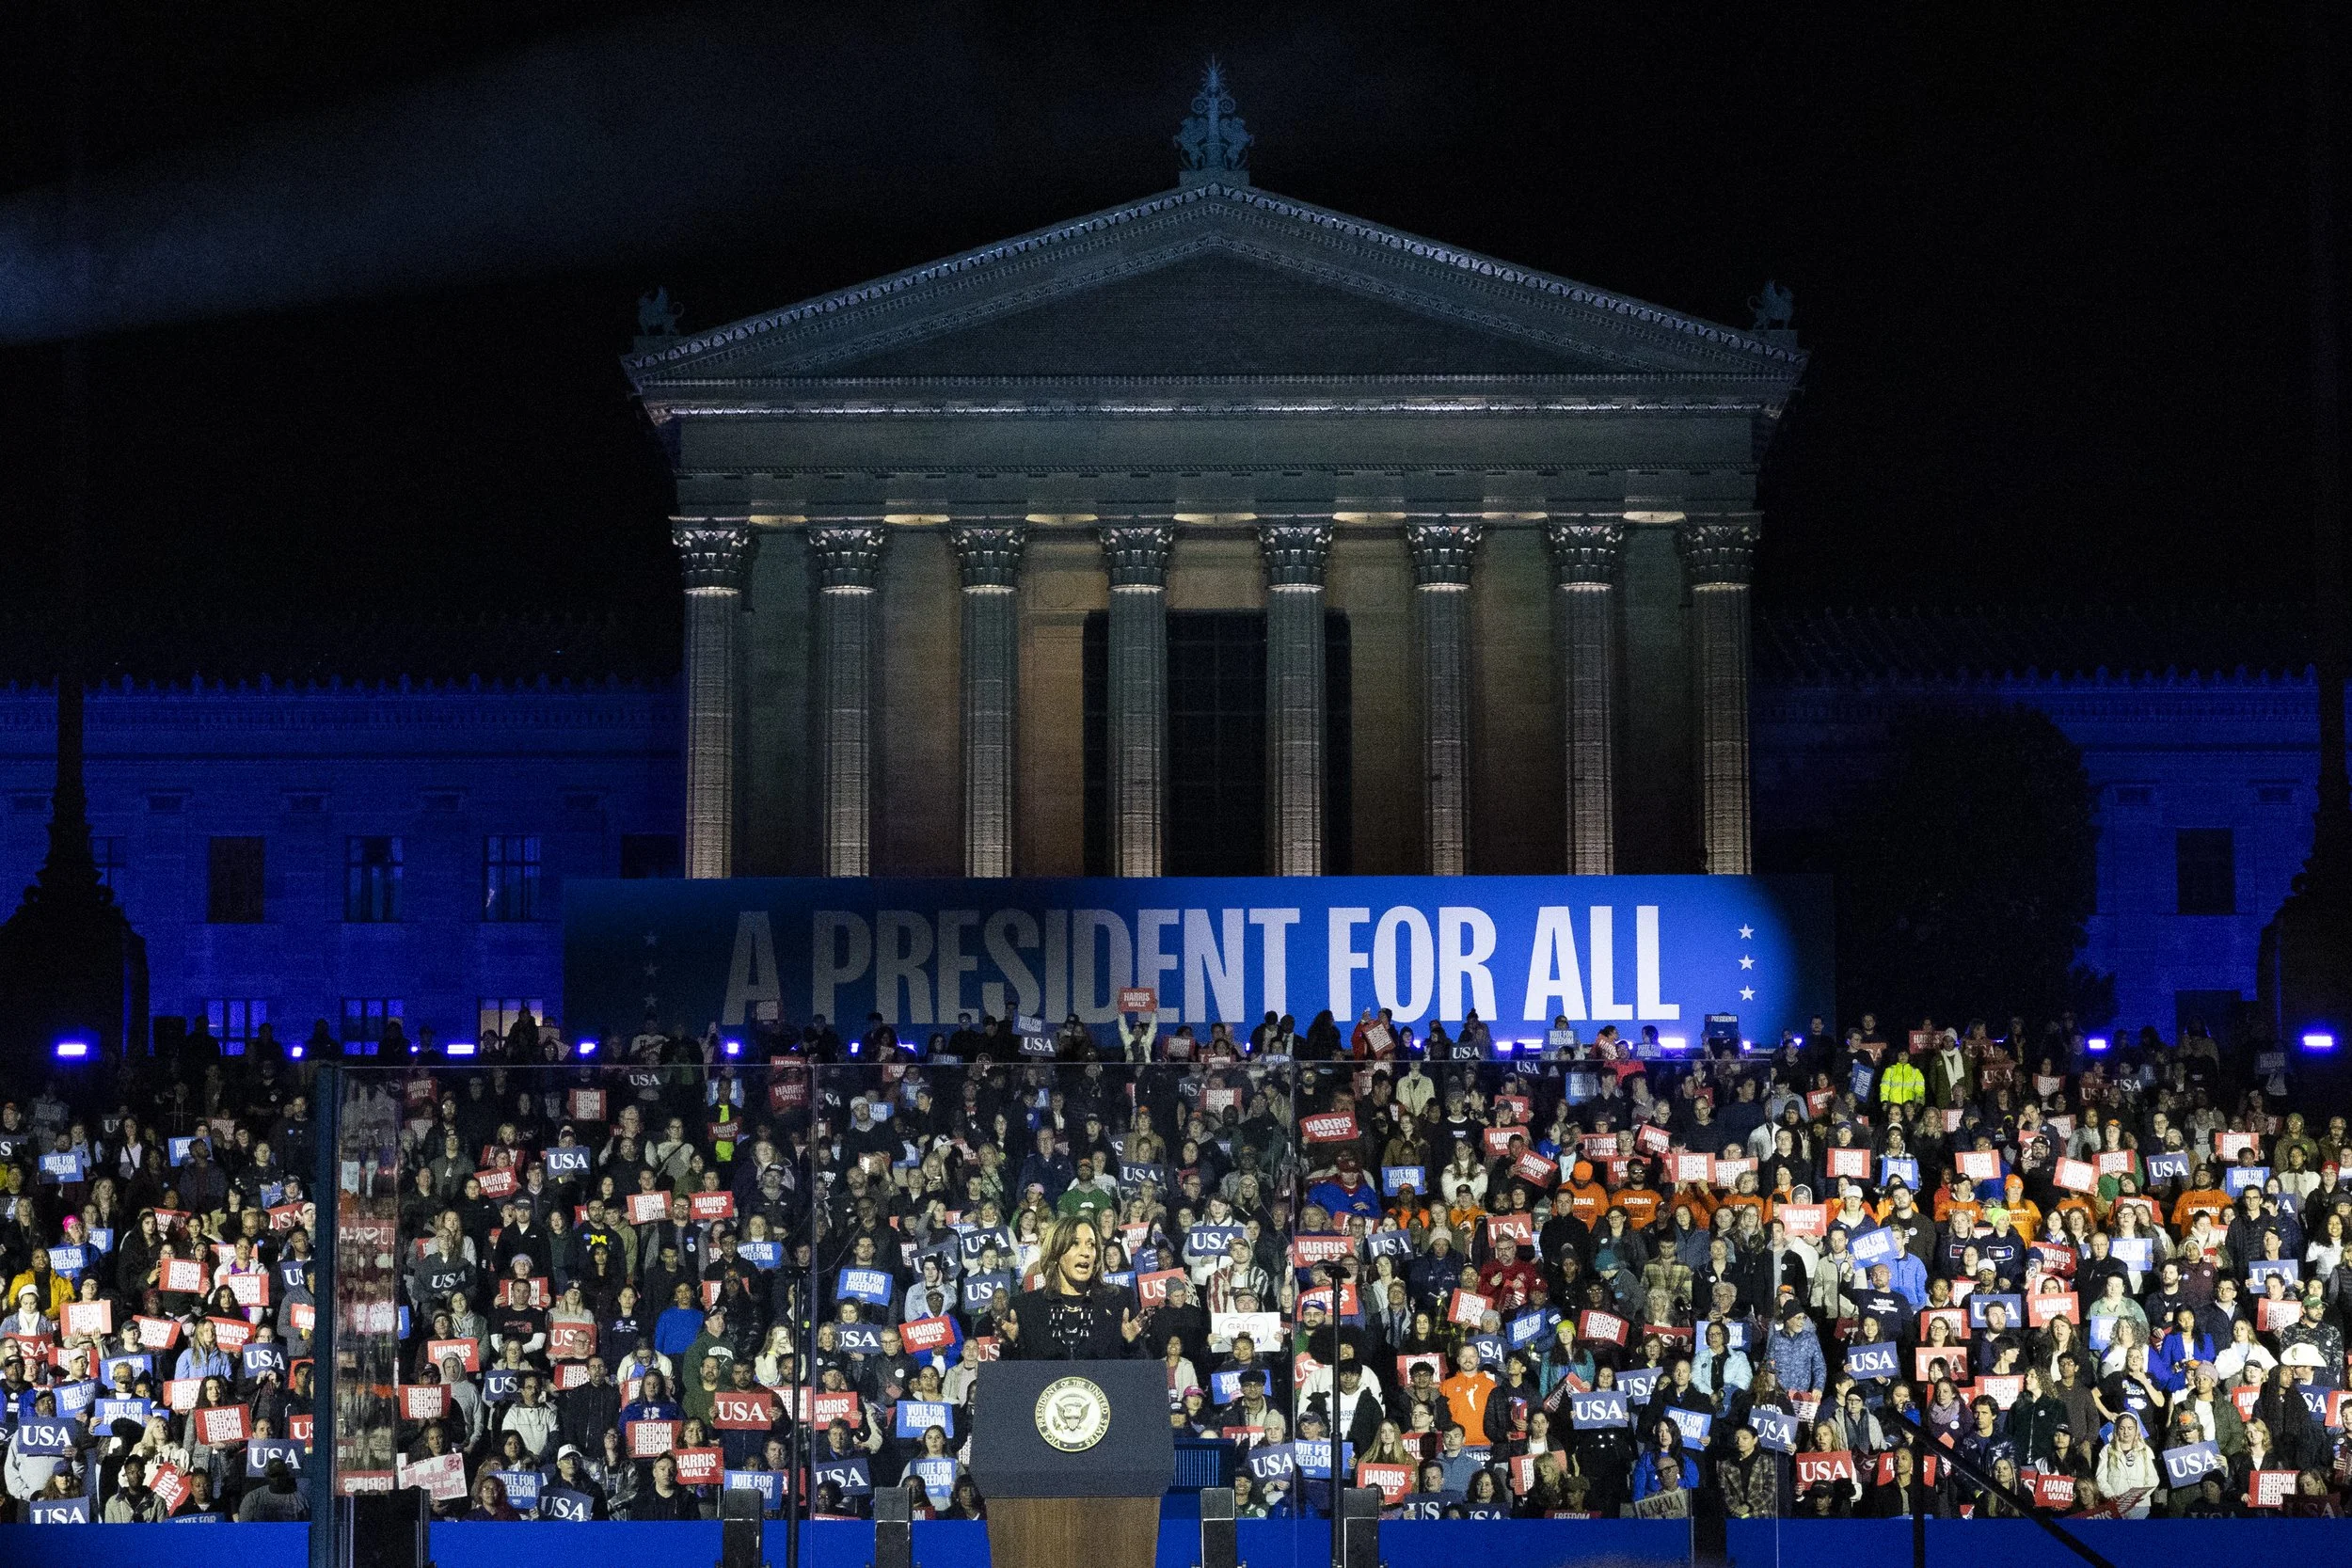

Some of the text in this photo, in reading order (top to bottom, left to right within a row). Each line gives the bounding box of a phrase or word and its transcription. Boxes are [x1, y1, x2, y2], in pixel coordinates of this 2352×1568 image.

[723, 906, 1679, 1026] A PRESIDENT FOR ALL
[1123, 991, 1150, 1003] HARRIS
[1128, 1000, 1146, 1008] WALZ
[1020, 1017, 1042, 1027] VOTE FOR
[1019, 1024, 1042, 1033] FREEDOM
[1024, 1037, 1054, 1052] USA
[1914, 1035, 1940, 1044] HARRIS
[1453, 1046, 1481, 1059] USA
[1517, 1061, 1539, 1074] USA
[629, 1074, 660, 1085] USA
[1571, 1072, 1584, 1085] VOTE
[1983, 1069, 2013, 1083] USA
[407, 1080, 433, 1092] HARRIS
[774, 1085, 805, 1097] HARRIS
[1571, 1083, 1597, 1097] FREEDOM
[576, 1092, 600, 1101] FREEDOM
[1206, 1089, 1234, 1099] FREEDOM
[576, 1101, 600, 1110] FREEDOM
[1206, 1098, 1234, 1106] FREEDOM
[576, 1110, 600, 1119] FREEDOM
[711, 1122, 739, 1134] HARRIS
[1306, 1117, 1352, 1132] HARRIS
[1314, 1127, 1349, 1137] WALZ
[1584, 1138, 1617, 1149] HARRIS
[1646, 1143, 1669, 1154] WALZ
[1589, 1148, 1613, 1157] WALZ
[44, 1155, 75, 1166] VOTE FOR
[549, 1153, 588, 1169] USA
[1522, 1153, 1551, 1175] HARRIS
[45, 1164, 77, 1175] FREEDOM
[1122, 1166, 1157, 1181] USA
[1389, 1168, 1419, 1180] VOTE FOR
[2151, 1161, 2188, 1178] USA
[2233, 1170, 2264, 1180] VOTE FOR
[479, 1172, 512, 1187] HARRIS
[1389, 1178, 1419, 1187] FREEDOM
[2233, 1178, 2264, 1188] FREEDOM
[485, 1182, 508, 1193] WALZ
[634, 1194, 664, 1204] FREEDOM
[694, 1196, 727, 1208] HARRIS
[636, 1202, 665, 1213] FREEDOM
[271, 1212, 302, 1230] USA
[637, 1210, 666, 1221] FREEDOM
[1786, 1210, 1821, 1222] HARRIS
[590, 1234, 608, 1244] M
[1489, 1224, 1530, 1242] USA
[1191, 1232, 1234, 1250] USA
[1851, 1232, 1886, 1251] VOTE FOR
[756, 1243, 772, 1253] FOR
[1298, 1242, 1347, 1255] HARRIS
[1371, 1239, 1411, 1257] USA
[1855, 1243, 1890, 1260] FREEDOM
[49, 1249, 82, 1261] VOTE FOR
[50, 1257, 83, 1269] FREEDOM
[431, 1270, 467, 1289] USA
[847, 1271, 885, 1284] VOTE FOR
[845, 1281, 884, 1294] FREEDOM
[1460, 1292, 1487, 1307] FREEDOM
[2035, 1300, 2072, 1311] HARRIS
[1459, 1302, 1485, 1316] FREEDOM
[1513, 1314, 1541, 1333] VOTE FOR
[1589, 1312, 1622, 1326] FREEDOM
[907, 1323, 946, 1338] HARRIS
[1227, 1323, 1261, 1332] GRITTY
[1513, 1323, 1541, 1342] FREEDOM
[1588, 1321, 1620, 1333] FREEDOM
[216, 1336, 243, 1345] WALZ
[914, 1334, 943, 1344] WALZ
[1586, 1328, 1618, 1341] FREEDOM
[434, 1345, 470, 1358] HARRIS
[246, 1351, 285, 1370] USA
[1851, 1352, 1895, 1371] USA
[488, 1377, 518, 1392] US
[60, 1386, 79, 1402] VOTE
[408, 1386, 442, 1398] FREEDOM
[408, 1398, 442, 1409] FREEDOM
[1037, 1385, 1057, 1427] PRESIDENT
[1089, 1385, 1108, 1415] UNITED
[104, 1402, 142, 1413] VOTE FOR
[203, 1407, 239, 1418] FREEDOM
[408, 1407, 442, 1418] FREEDOM
[717, 1402, 768, 1422] USA
[907, 1403, 945, 1417] VOTE FOR
[1575, 1400, 1623, 1420] USA
[205, 1418, 241, 1430] FREEDOM
[907, 1416, 946, 1428] FREEDOM
[1687, 1414, 1703, 1427] FOR
[635, 1424, 672, 1433] FREEDOM
[1084, 1418, 1108, 1445] STATES
[1751, 1417, 1793, 1445] USA
[21, 1425, 72, 1447] USA
[207, 1430, 243, 1440] FREEDOM
[635, 1433, 672, 1444] FREEDOM
[1043, 1430, 1060, 1447] VICE
[635, 1444, 672, 1454] FREEDOM
[916, 1462, 951, 1475] VOTE FOR
[1251, 1452, 1293, 1478] USA
[2168, 1449, 2220, 1478] USA
[681, 1467, 710, 1477] WALZ
[1365, 1470, 1406, 1484] HARRIS
[1801, 1460, 1848, 1482] USA
[518, 1474, 536, 1486] FOR
[731, 1475, 773, 1486] VOTE FOR
[2260, 1473, 2296, 1484] FREEDOM
[2259, 1484, 2296, 1495] FREEDOM
[540, 1496, 585, 1522] USA
[33, 1507, 86, 1524] USA
